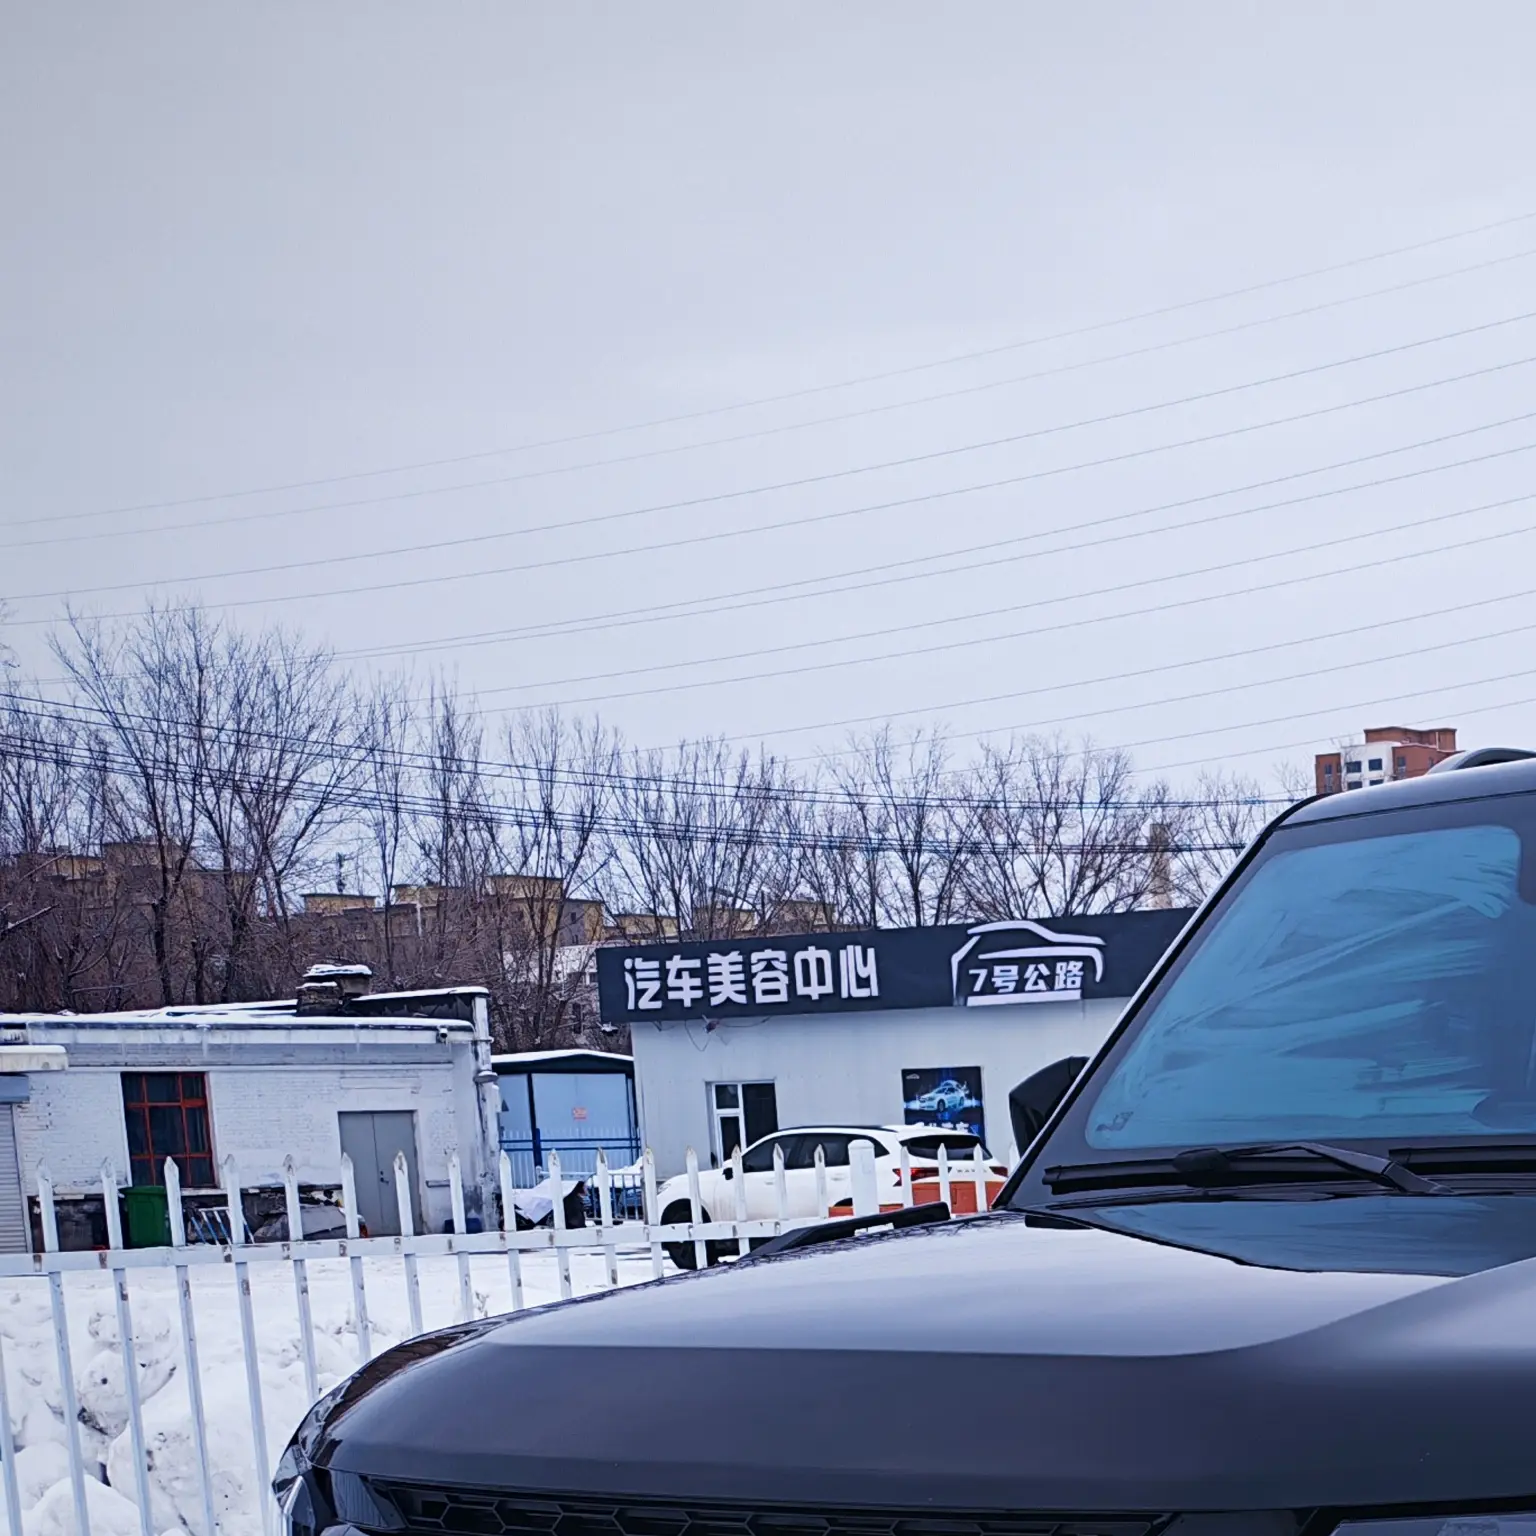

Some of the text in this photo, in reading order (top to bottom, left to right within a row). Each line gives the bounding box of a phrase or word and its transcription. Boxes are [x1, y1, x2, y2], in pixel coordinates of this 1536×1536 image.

[624, 945, 879, 1010] 汽车美容中心
[968, 960, 1084, 993] 7号公路
